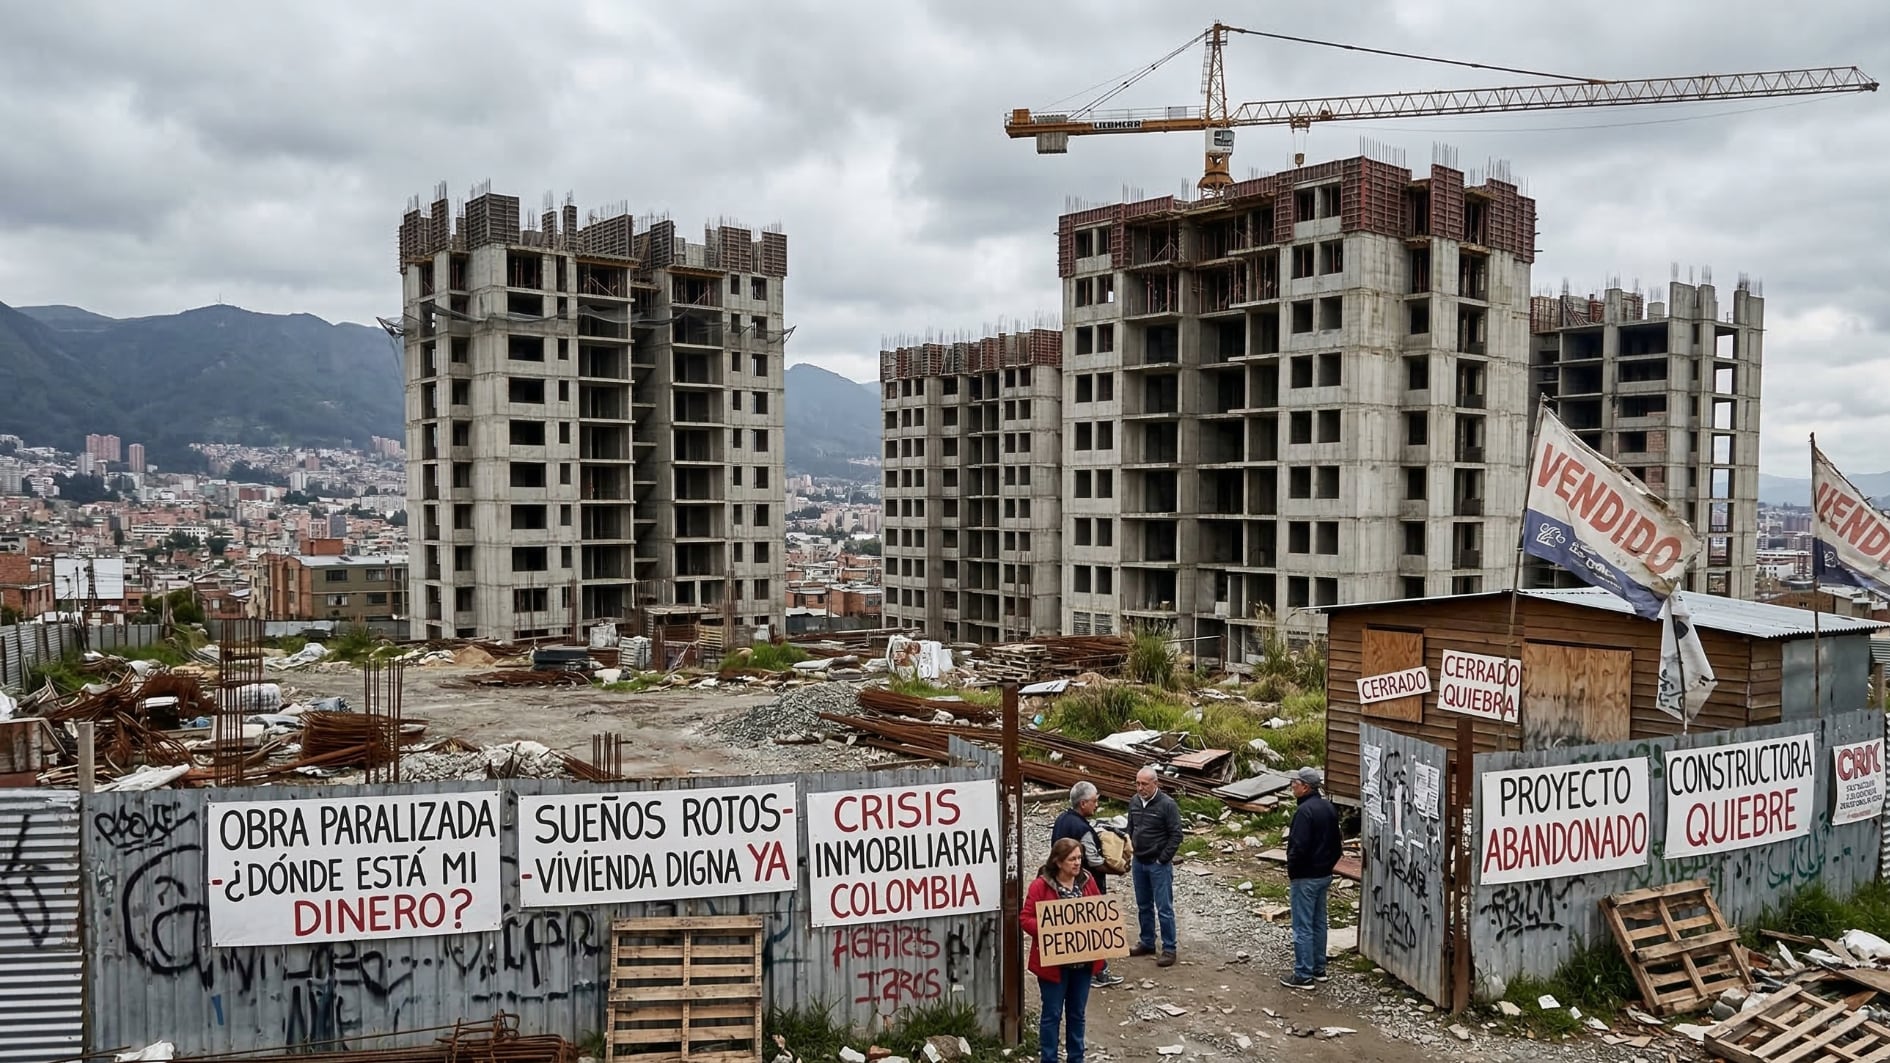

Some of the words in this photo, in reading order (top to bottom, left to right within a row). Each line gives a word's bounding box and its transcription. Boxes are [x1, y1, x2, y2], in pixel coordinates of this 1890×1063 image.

[1537, 443, 1682, 574] VENDIDO
[1361, 670, 1427, 700] CERRADO
[1444, 655, 1519, 688] CERRADO
[1443, 684, 1516, 718] QUIEBRA
[1500, 766, 1631, 817] PROYECTO
[1669, 740, 1813, 796] CONSTRUCTORA
[219, 808, 310, 851] OBRA
[320, 799, 497, 846] PARALIZADA
[535, 795, 666, 845] SUEÑOS
[834, 789, 961, 834] CRISIS
[1686, 788, 1798, 847] QUIEBRE
[666, 848, 742, 888] DIGNA
[746, 841, 791, 882] YA
[815, 828, 997, 879] INMOBILIARIA
[1483, 813, 1647, 874] ABANDONADO
[356, 846, 427, 891] ESTÁ
[442, 851, 477, 885] MI
[294, 887, 474, 937] DINERO?
[830, 873, 981, 919] COLOMBIA
[1041, 900, 1120, 929] AHORROS
[1042, 926, 1125, 957] PERDIDOS
